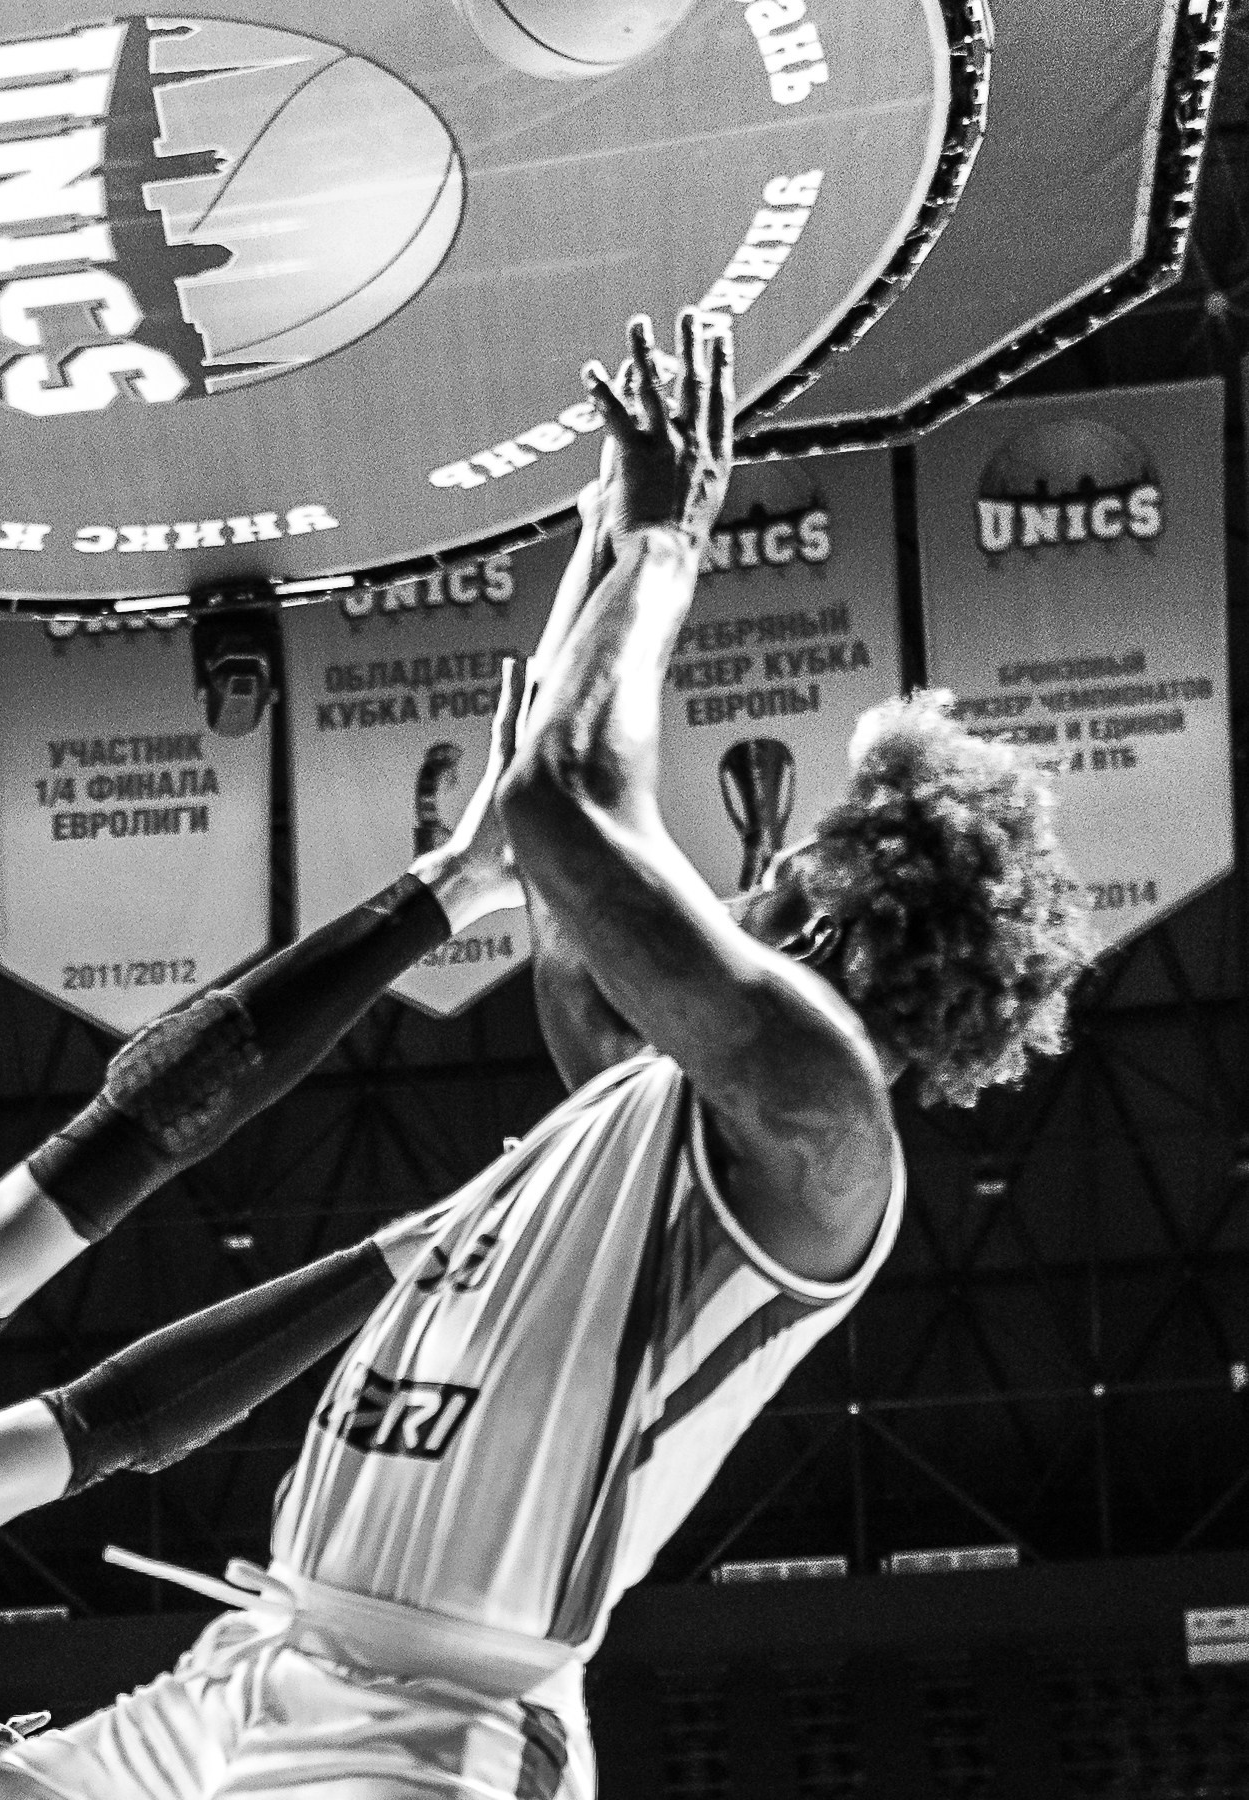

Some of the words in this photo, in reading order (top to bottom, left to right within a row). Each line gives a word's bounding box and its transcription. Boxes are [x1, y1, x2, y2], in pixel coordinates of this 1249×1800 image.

[699, 510, 831, 573] NICS
[976, 484, 1161, 553] UNICS
[676, 600, 851, 657] РЕБРЯНЫЙ
[325, 647, 517, 693] ОБЛАДАТЕЛ
[668, 654, 753, 692] ИЗЕР
[764, 639, 871, 681] КУБКА
[317, 694, 420, 732] КУБКА
[429, 684, 503, 720] РОС
[686, 684, 820, 727] ЕВРОПЫ
[47, 734, 204, 770] УЧАСТНИК
[34, 777, 77, 810] 1/4
[85, 767, 220, 803] ФИНАЛА
[51, 805, 210, 842] ЕВРОЛИГИ
[61, 959, 197, 991] 2011/2012
